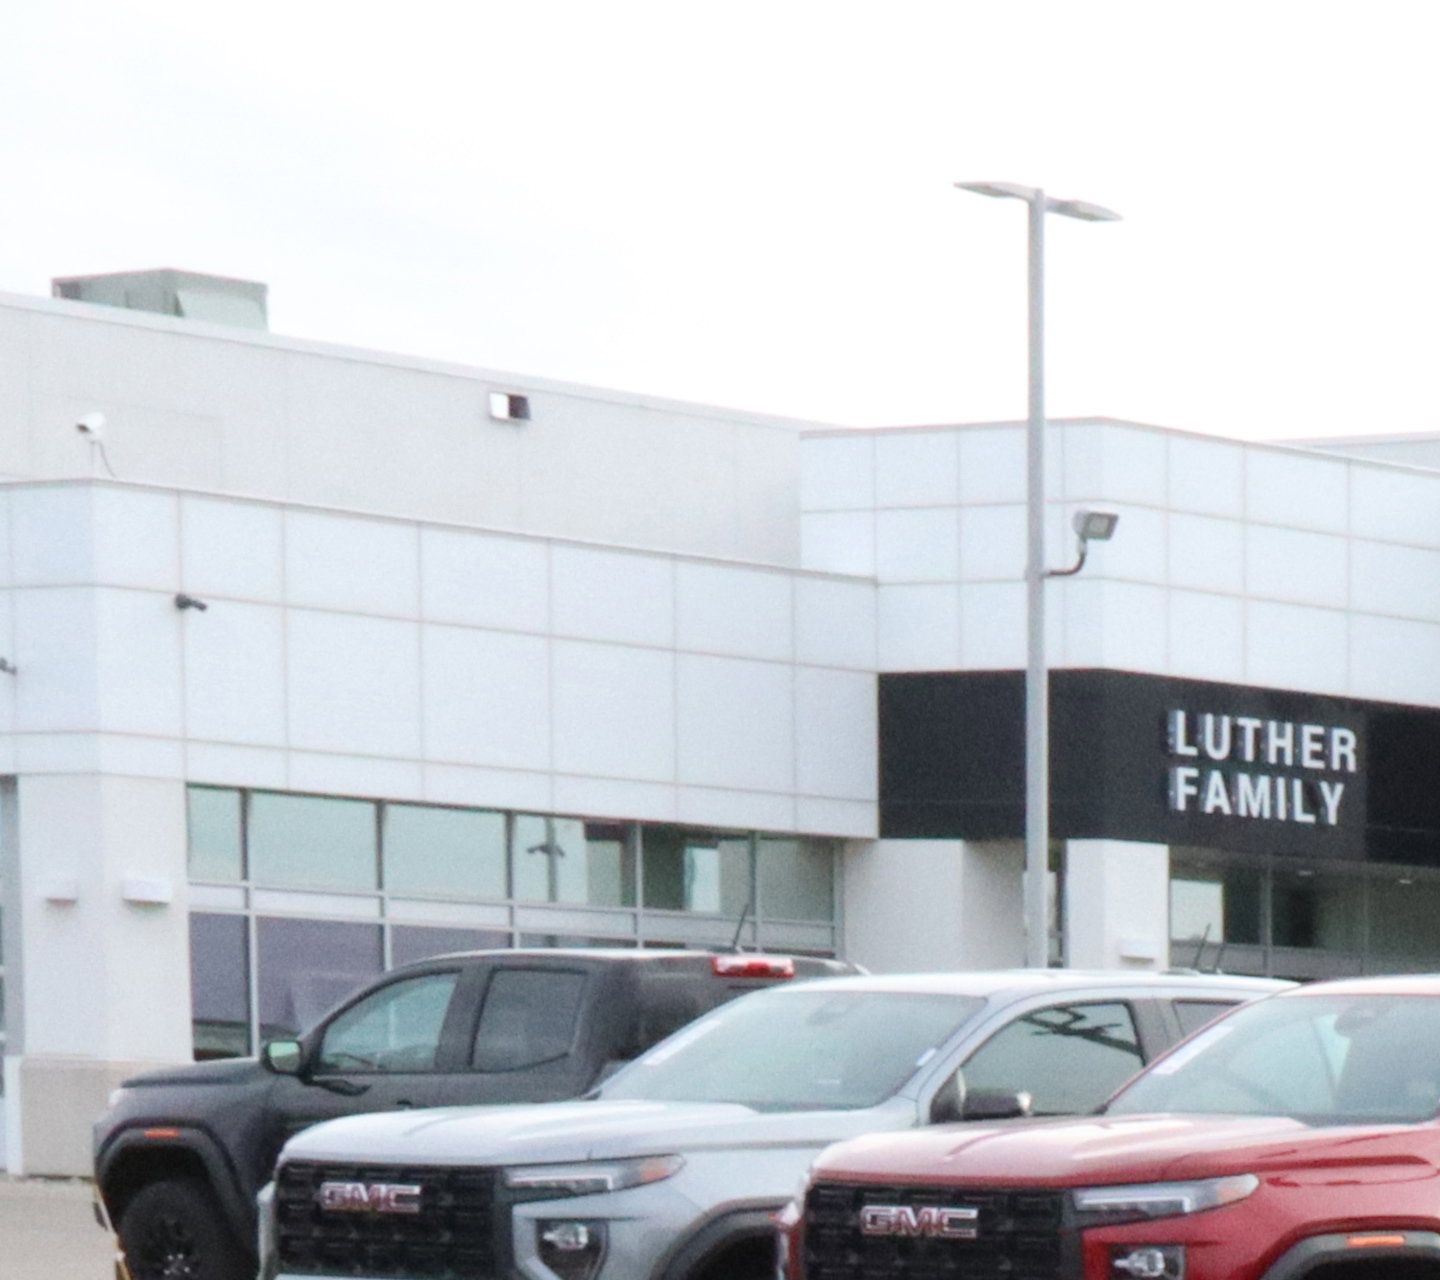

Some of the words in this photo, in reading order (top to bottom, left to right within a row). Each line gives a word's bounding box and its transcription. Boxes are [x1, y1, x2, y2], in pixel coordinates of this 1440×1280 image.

[1170, 709, 1358, 773] LUTHER
[1170, 766, 1345, 826] FAMILY
[321, 1181, 421, 1213] GMC
[861, 1205, 979, 1237] GMC
